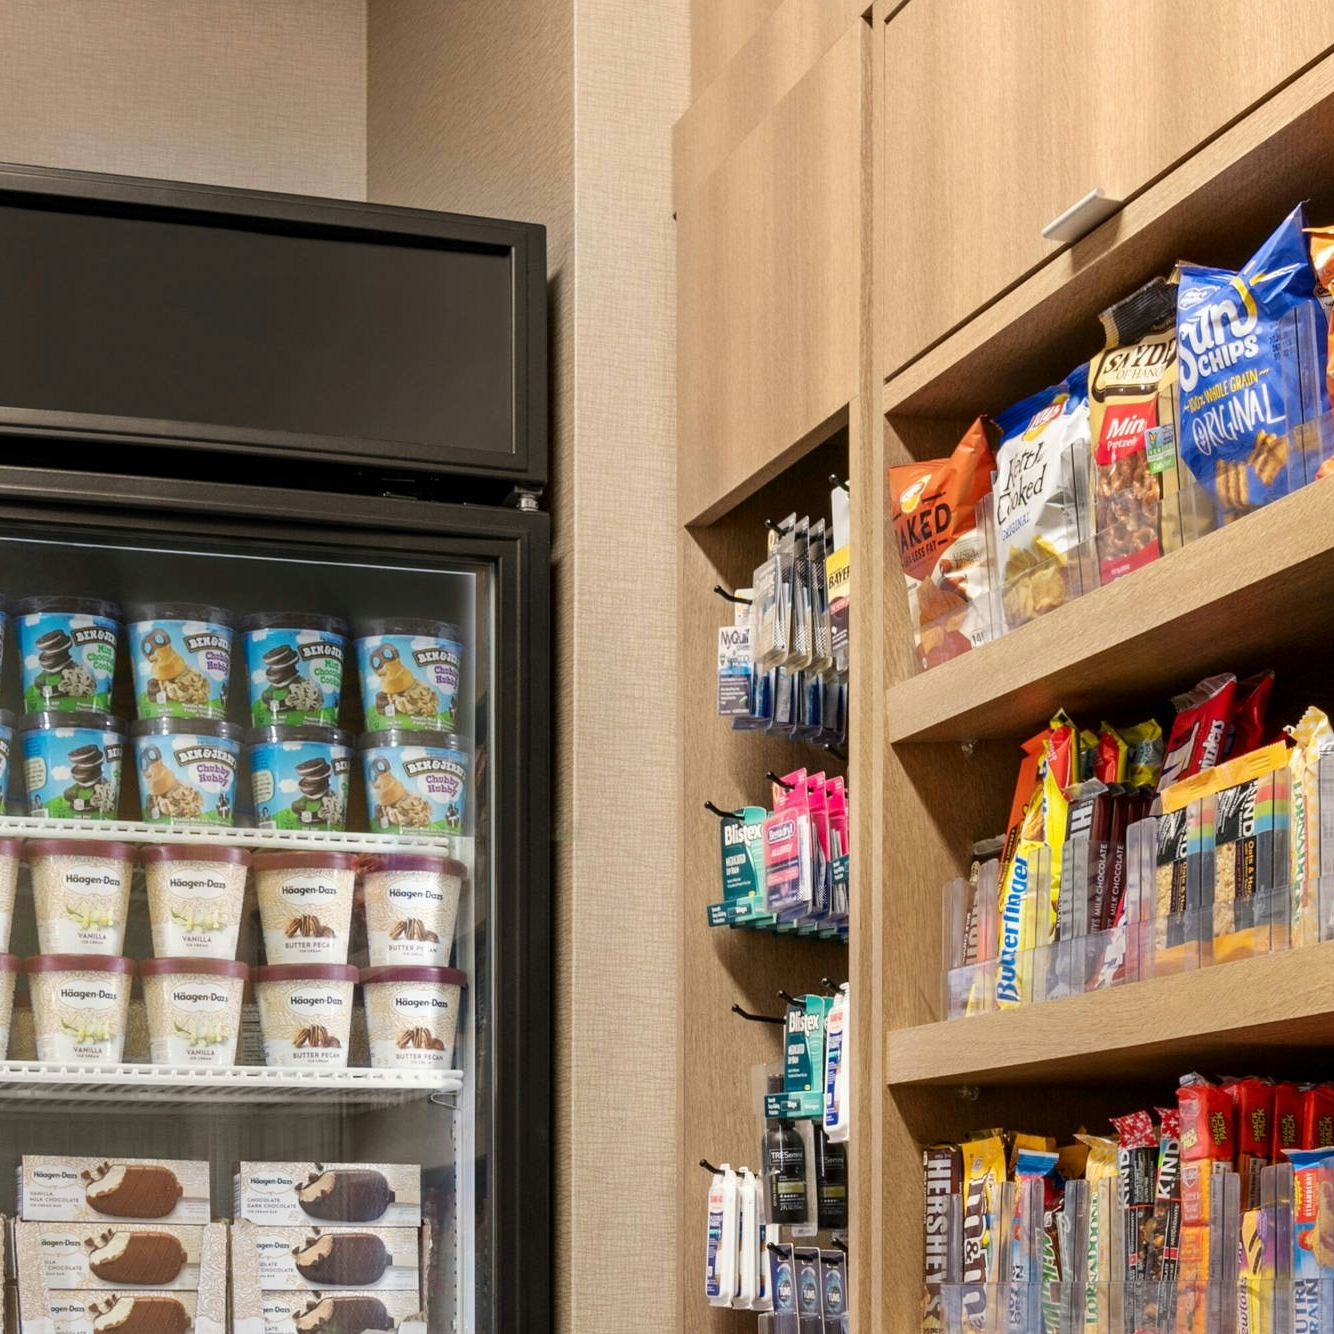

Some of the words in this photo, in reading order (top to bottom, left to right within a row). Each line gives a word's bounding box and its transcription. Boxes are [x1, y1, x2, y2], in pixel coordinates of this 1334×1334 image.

[1179, 299, 1259, 392] Sun
[1197, 335, 1259, 376] CHIPS
[1205, 382, 1229, 405] WHOLE
[1229, 369, 1259, 396] GRAIN
[1192, 382, 1286, 456] ORIGINAL
[1096, 843, 1108, 891] CHOCOLATE
[77, 932, 107, 940] VANILLA
[293, 1051, 319, 1059] BUTTER
[320, 1051, 341, 1059] PECAN
[1158, 1139, 1182, 1200] KIND
